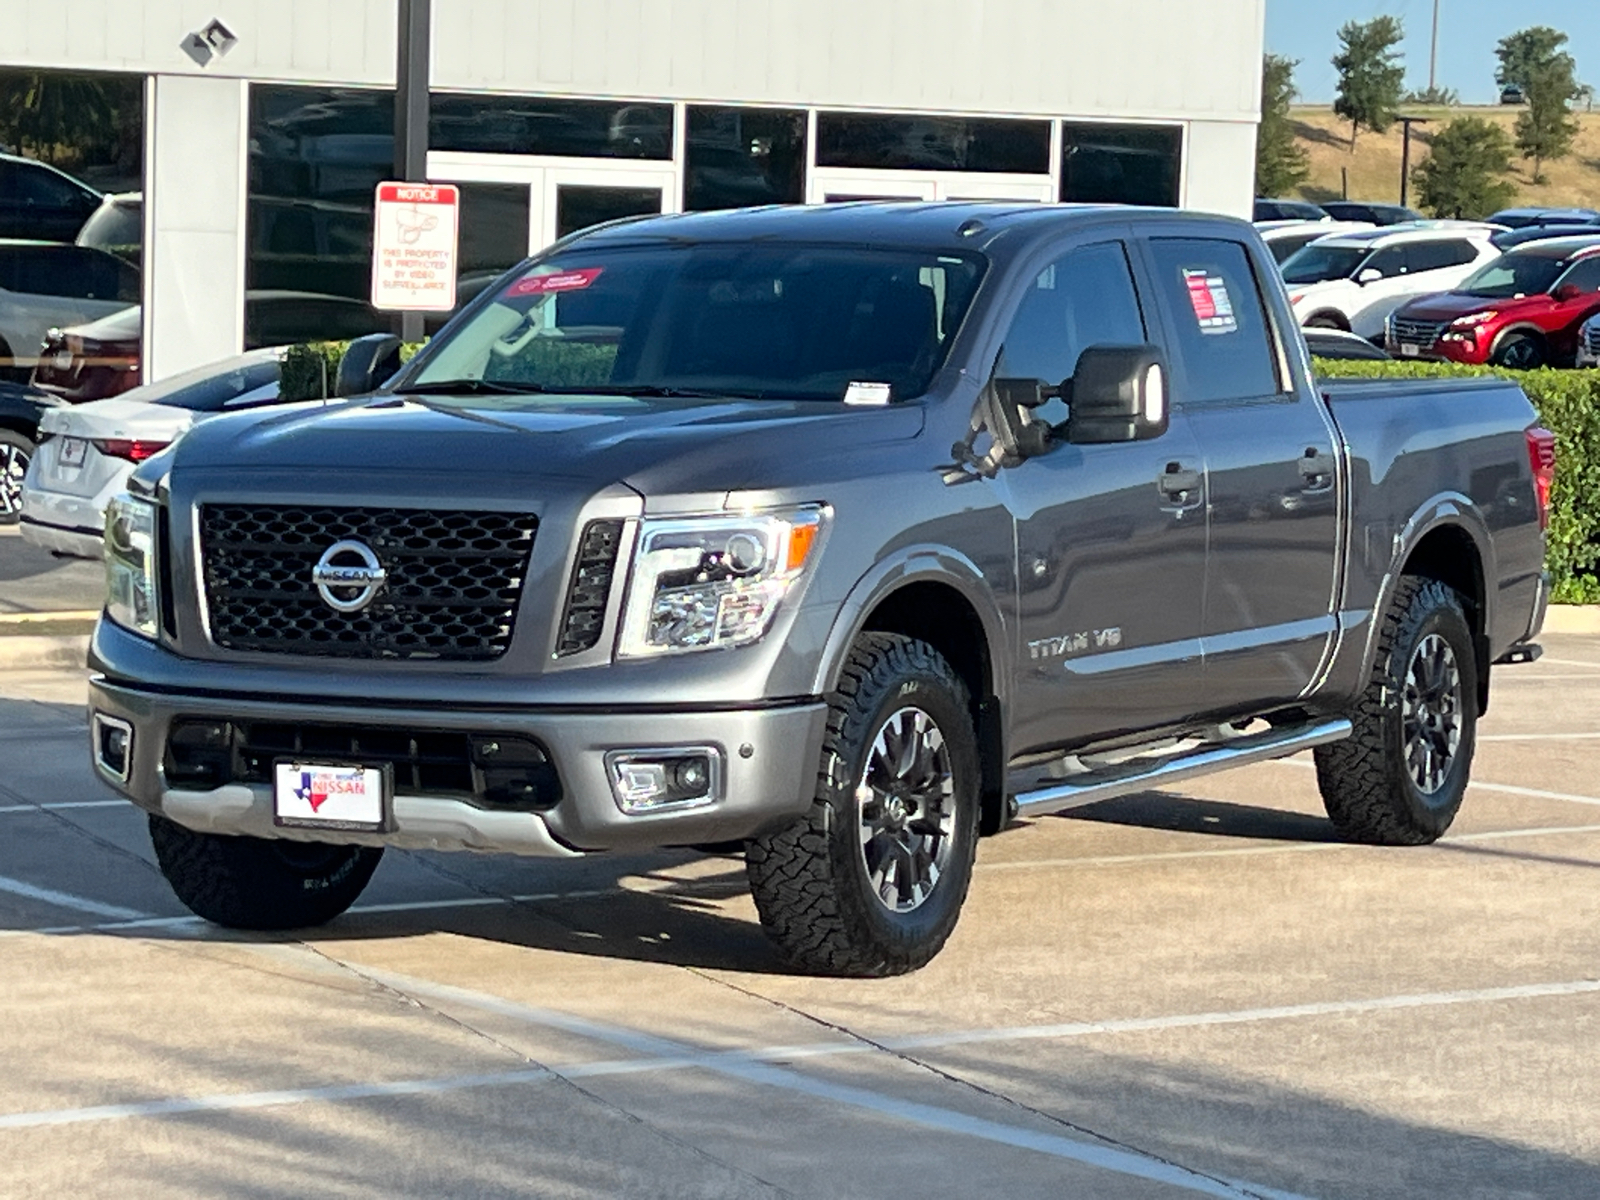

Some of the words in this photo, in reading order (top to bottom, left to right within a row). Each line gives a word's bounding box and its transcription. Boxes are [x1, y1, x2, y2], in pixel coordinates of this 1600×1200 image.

[398, 188, 439, 201] NOTICE
[382, 246, 401, 257] THIS
[405, 248, 450, 259] PROPERTY
[383, 258, 392, 268] IS
[395, 259, 447, 270] PROTECTED
[394, 269, 406, 278] BY
[409, 270, 436, 279] VIDEO
[382, 279, 447, 290] SURVEILLANCE
[318, 569, 375, 582] NISSAN
[1028, 631, 1088, 658] TITAN
[312, 780, 366, 795] NISSAN
